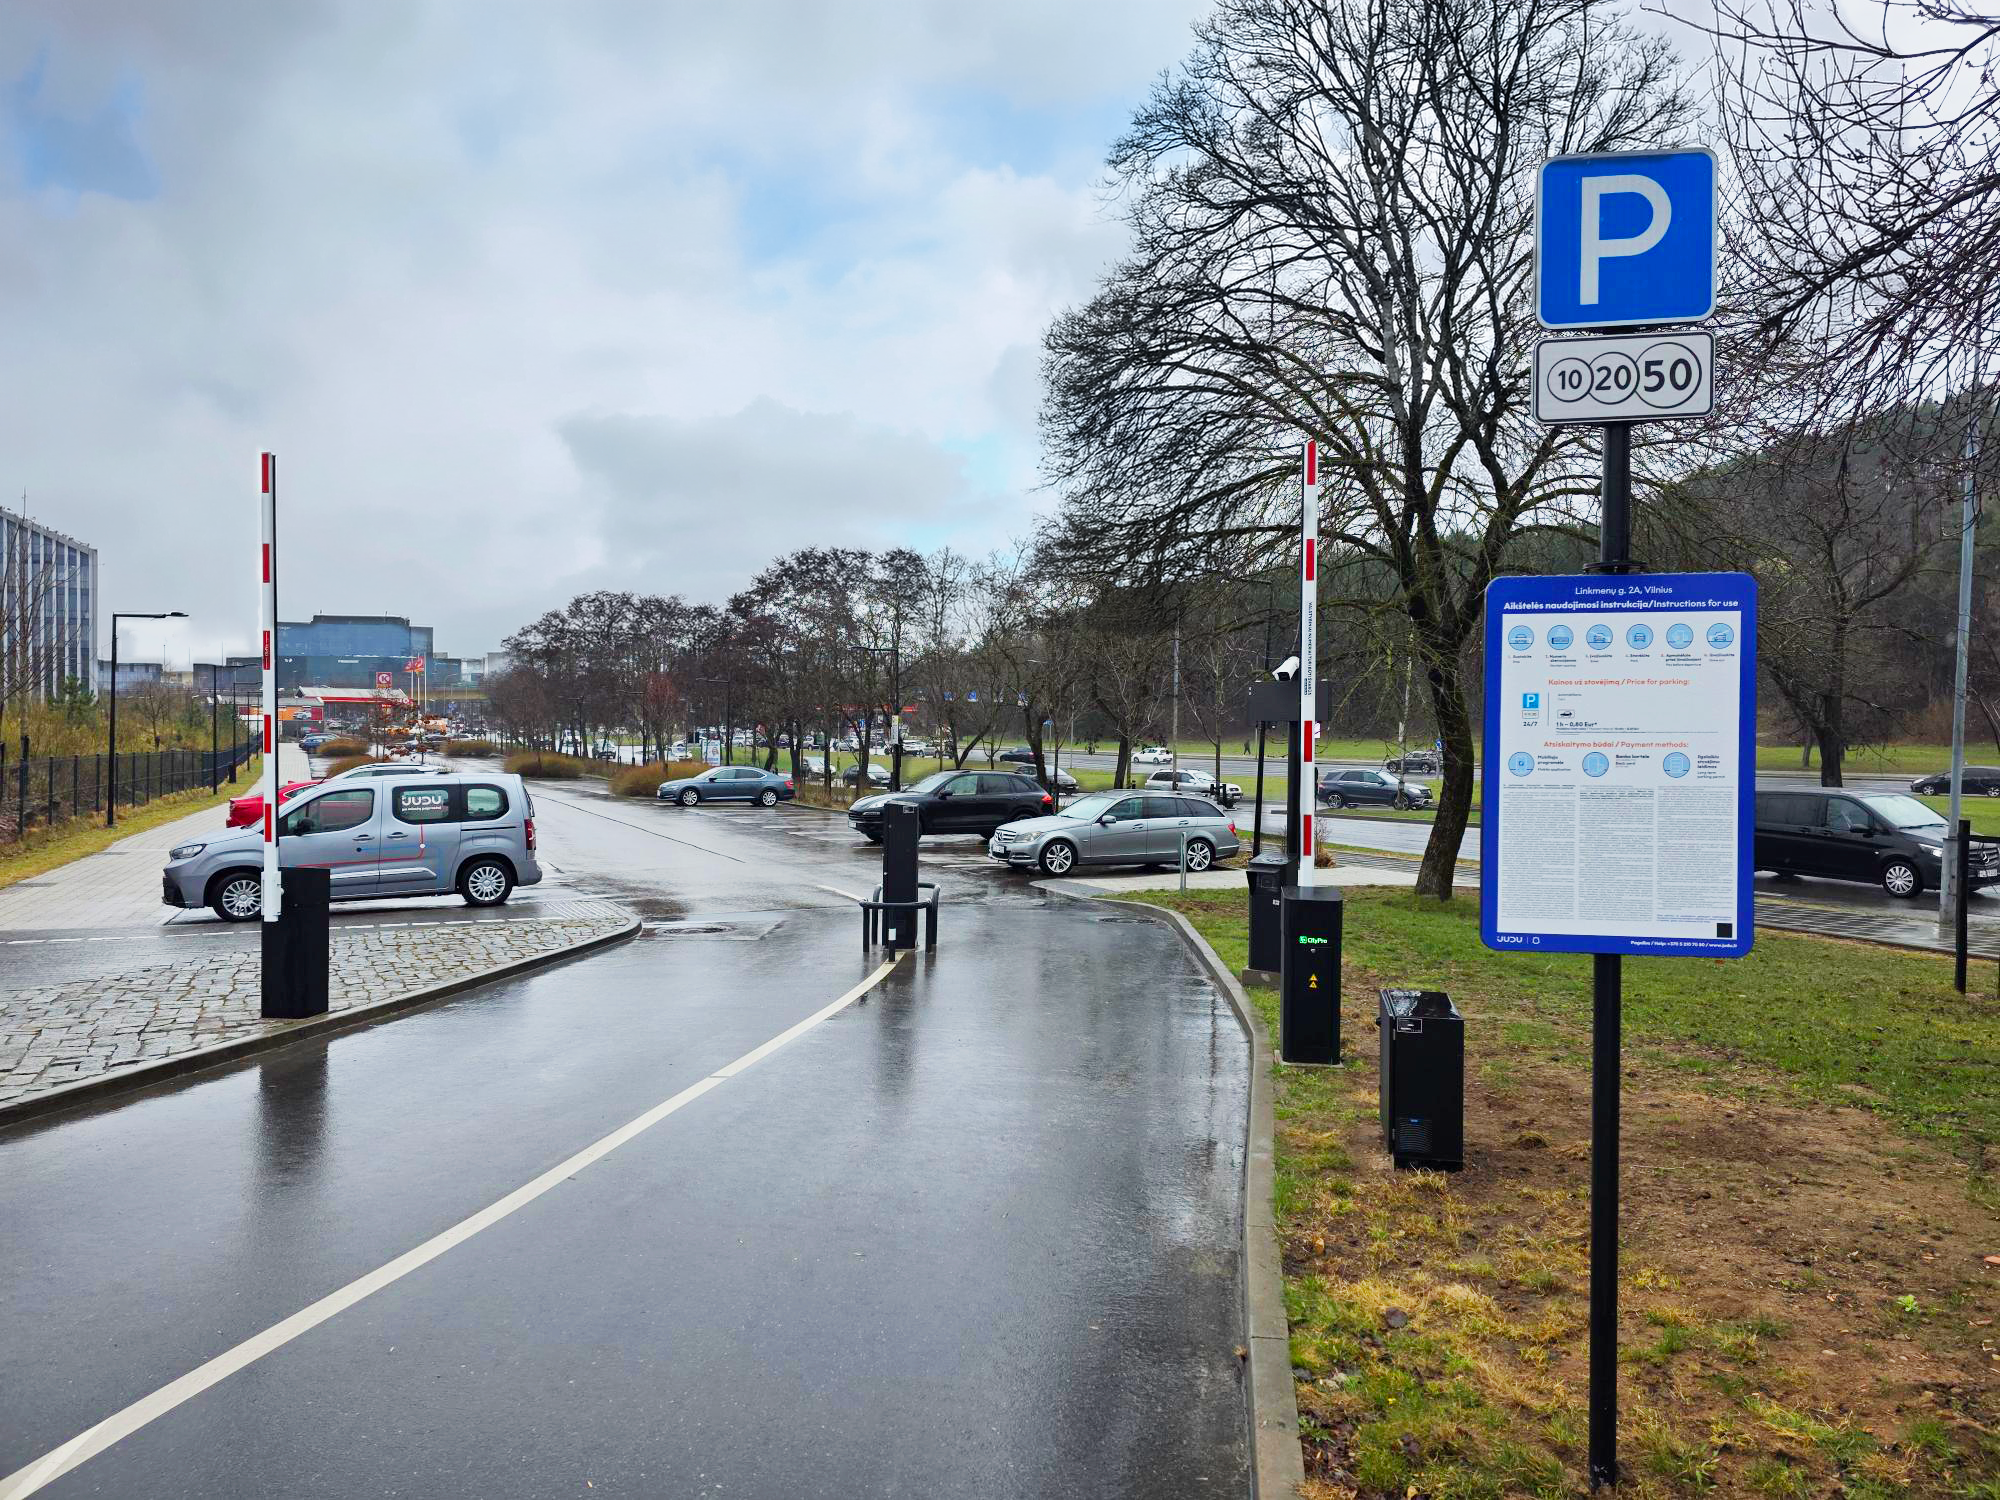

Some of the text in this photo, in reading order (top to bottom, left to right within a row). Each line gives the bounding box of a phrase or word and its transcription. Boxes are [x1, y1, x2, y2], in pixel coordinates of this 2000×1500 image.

[1579, 174, 1672, 305] P
[1558, 358, 1693, 393] 10 20 50
[1618, 587, 1627, 596] g.
[1628, 586, 1643, 595] 2A,
[1644, 585, 1673, 594] Vilnius
[1503, 601, 1544, 610] Aikštelės
[1545, 600, 1599, 611] naudojimosi
[1600, 599, 1706, 610] instrukcija/Instructions
[1708, 598, 1721, 607] for
[1659, 678, 1690, 687] parking:
[1526, 694, 1536, 708] P
[1543, 741, 1592, 749] Atsiskaitymo
[1592, 740, 1614, 748] būdai
[1620, 741, 1654, 749] Payment
